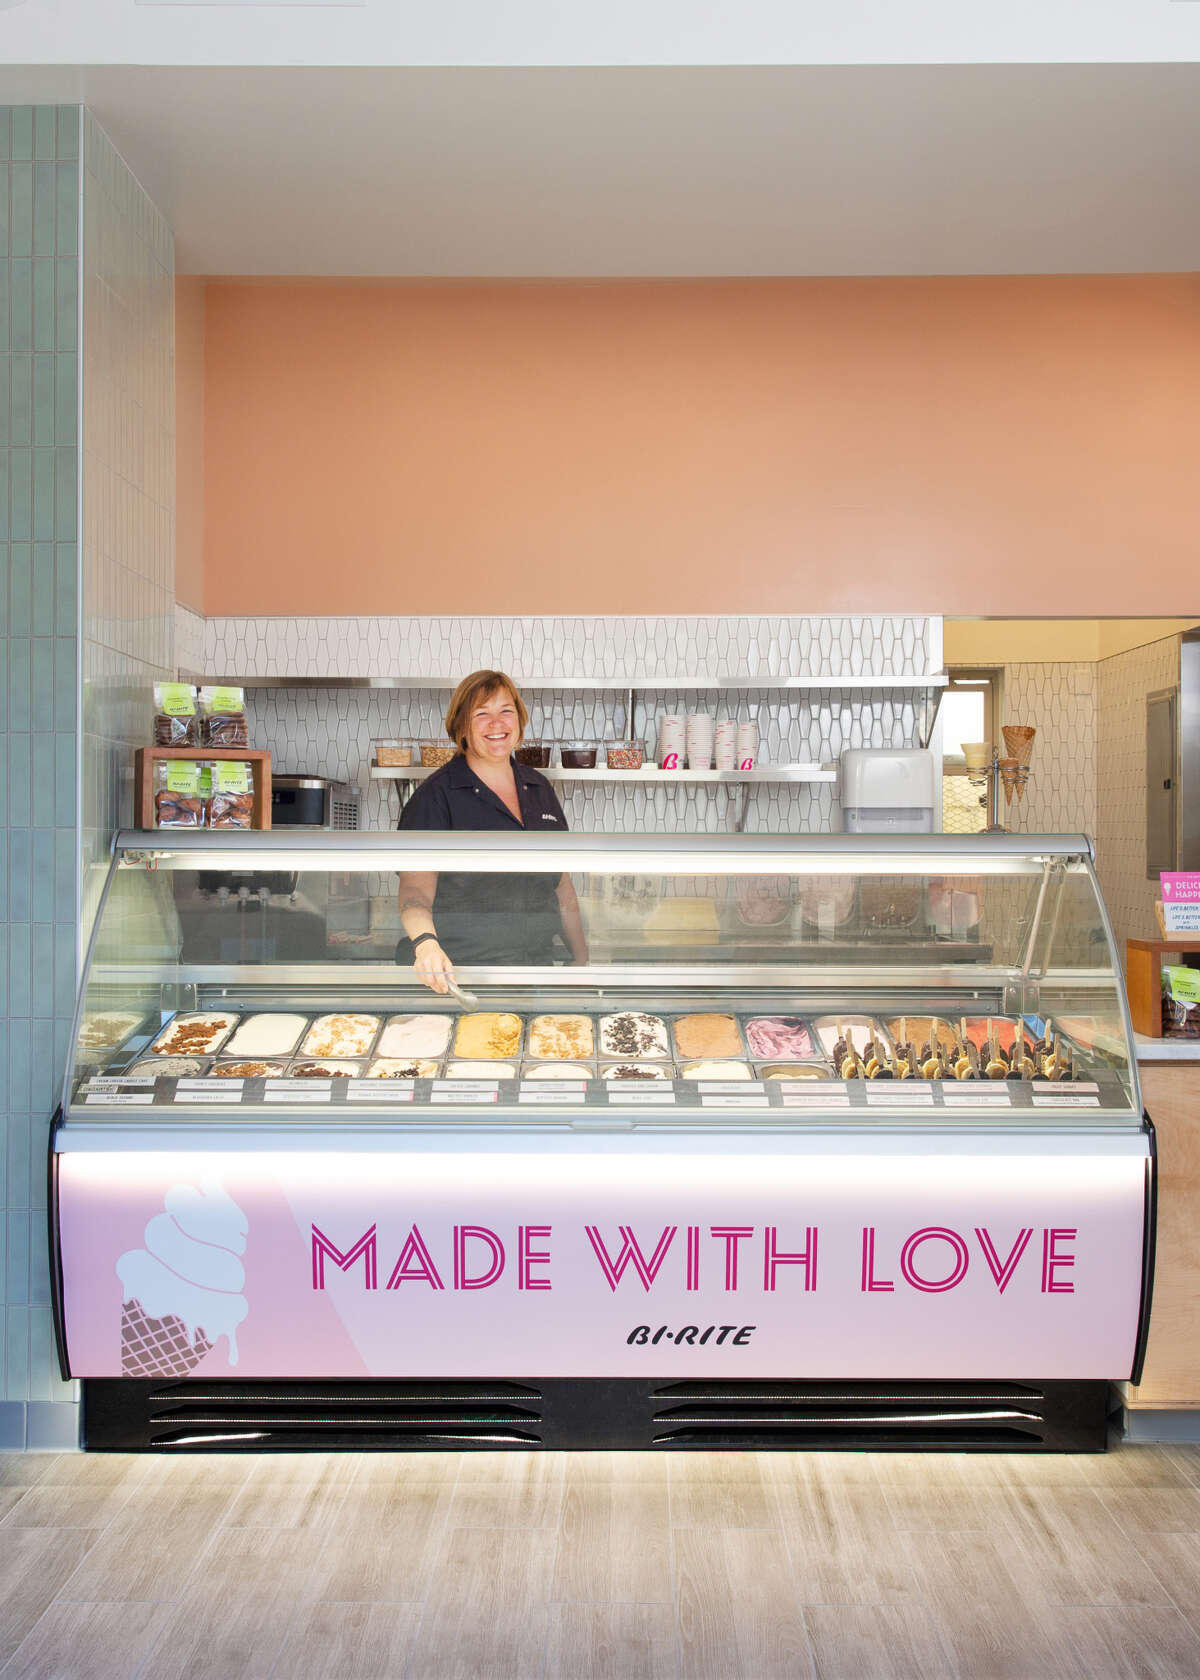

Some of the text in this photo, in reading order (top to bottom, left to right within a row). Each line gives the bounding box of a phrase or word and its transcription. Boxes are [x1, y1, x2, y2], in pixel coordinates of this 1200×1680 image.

[311, 1223, 1078, 1295] MADE WITH LOVE
